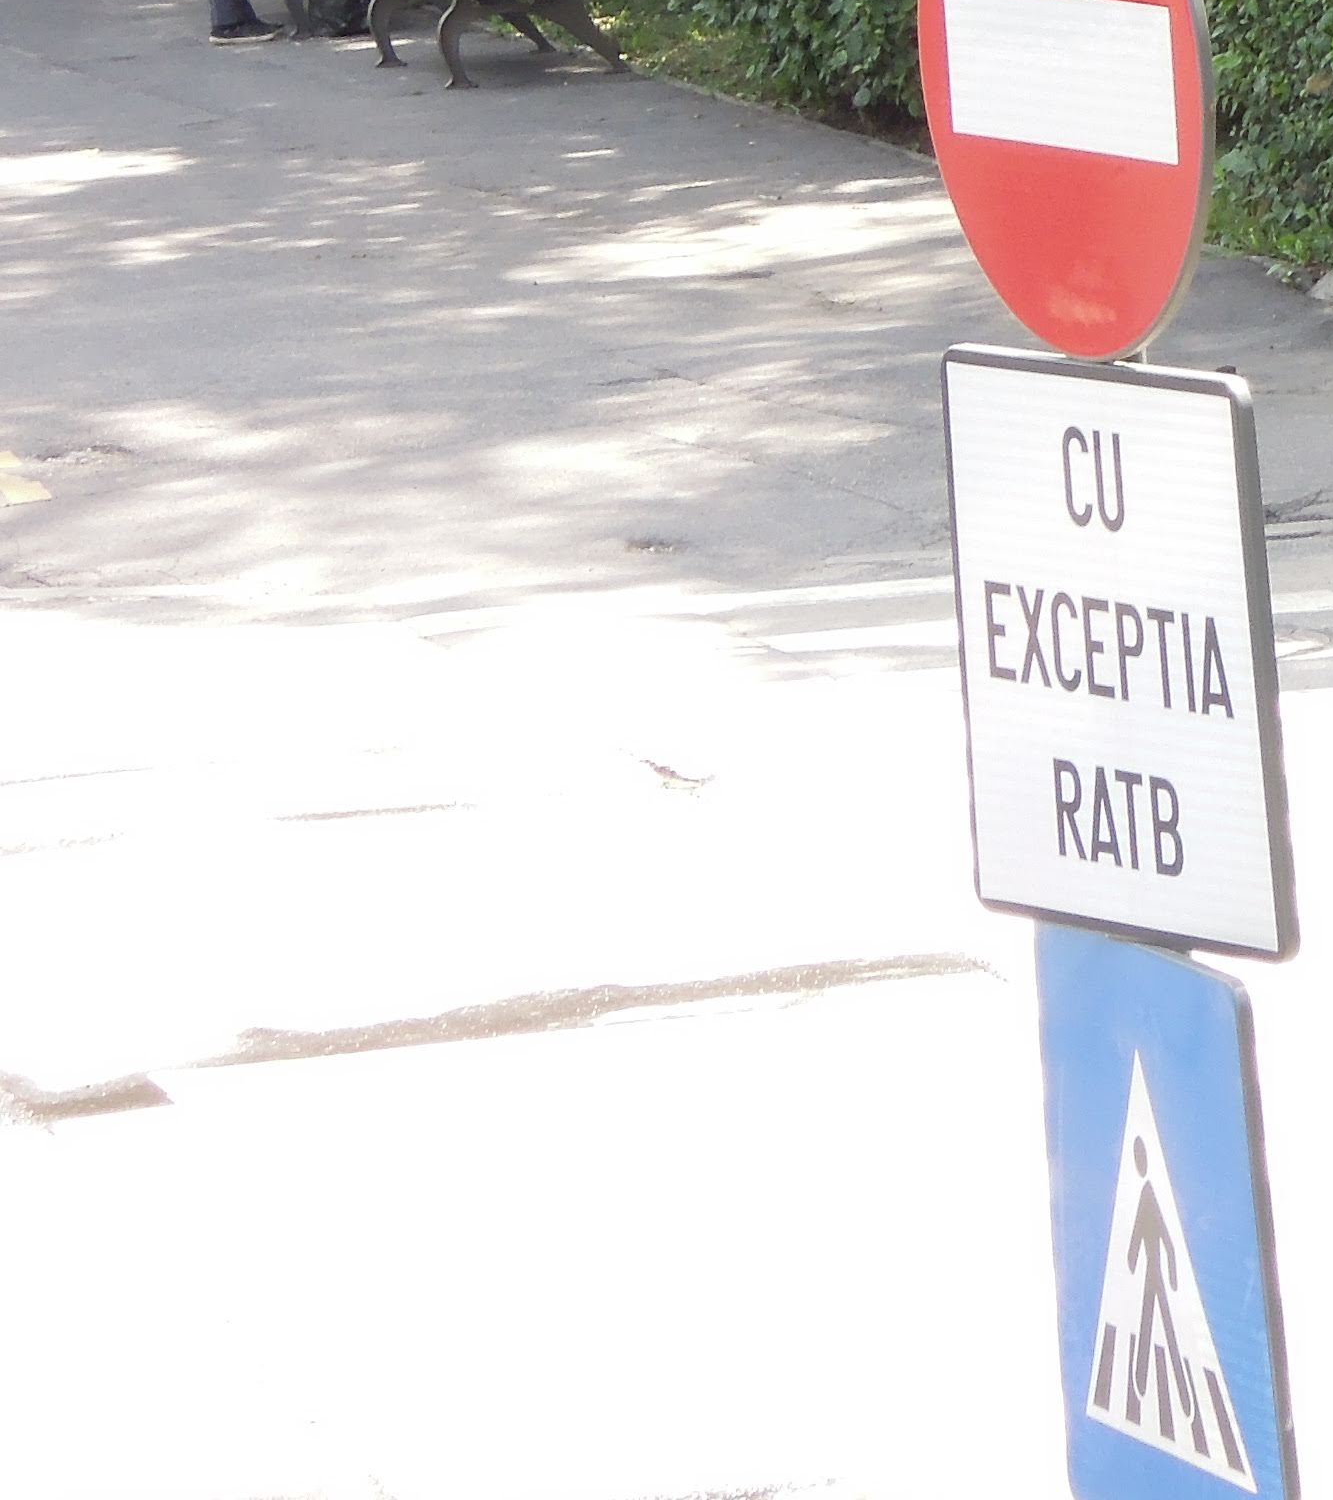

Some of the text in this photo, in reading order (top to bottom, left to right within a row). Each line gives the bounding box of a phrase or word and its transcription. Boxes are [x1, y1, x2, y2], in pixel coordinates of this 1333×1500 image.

[1062, 426, 1126, 533] CU
[983, 579, 1235, 720] EXCEPTIA
[1052, 756, 1185, 878] RATB
